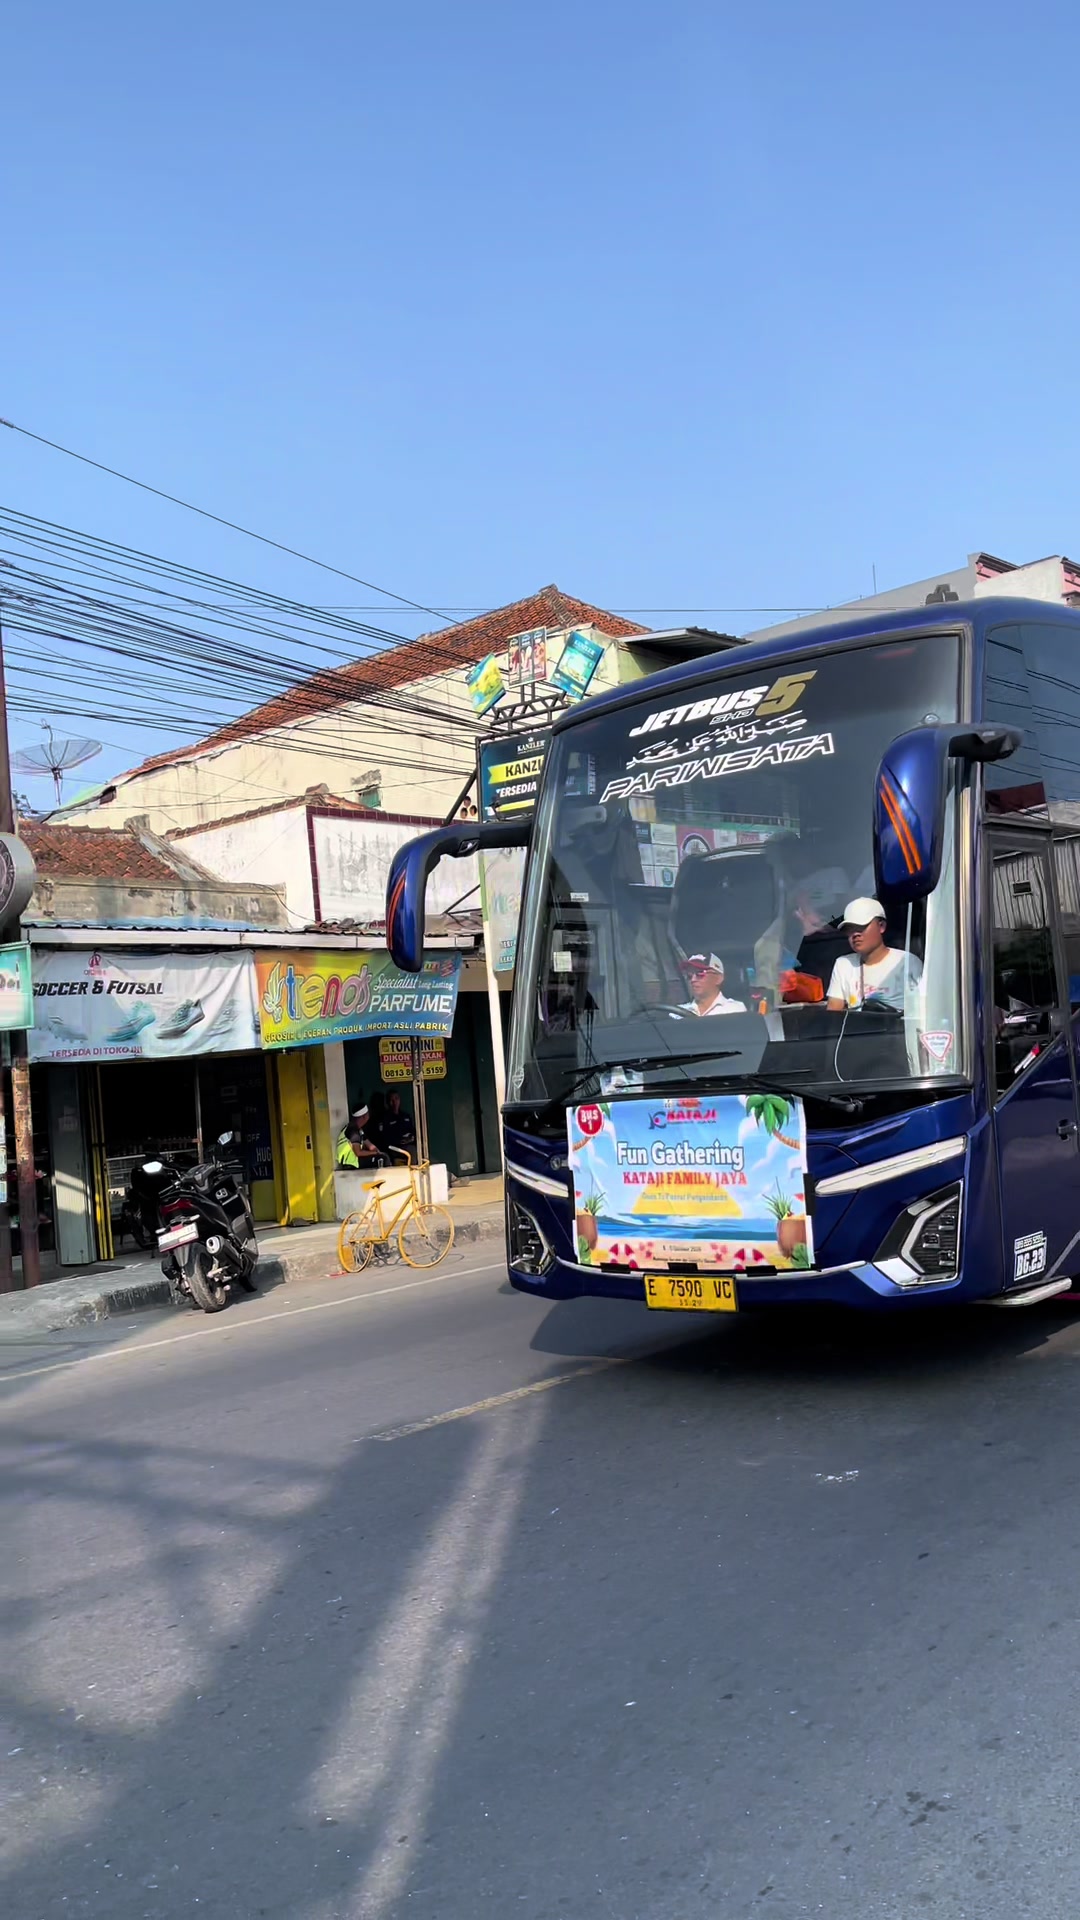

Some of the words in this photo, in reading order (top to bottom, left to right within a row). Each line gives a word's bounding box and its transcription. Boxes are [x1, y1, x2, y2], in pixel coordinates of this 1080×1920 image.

[599, 732, 834, 804] PARIWISATA
[92, 980, 103, 995] &
[107, 980, 164, 995] FUTSAL
[368, 994, 453, 1013] PARFUME
[394, 1021, 412, 1030] ASLI
[414, 1021, 449, 1032] PABRIK
[104, 1045, 129, 1055] TOKO
[617, 1141, 648, 1165] Fun
[651, 1138, 744, 1171] Gathering
[623, 1171, 665, 1187] KATAJI
[666, 1171, 712, 1185] FAMILY
[715, 1171, 747, 1188] JAYA
[648, 1279, 656, 1296] E
[668, 1279, 702, 1297] 7590
[713, 1280, 731, 1299] VC
